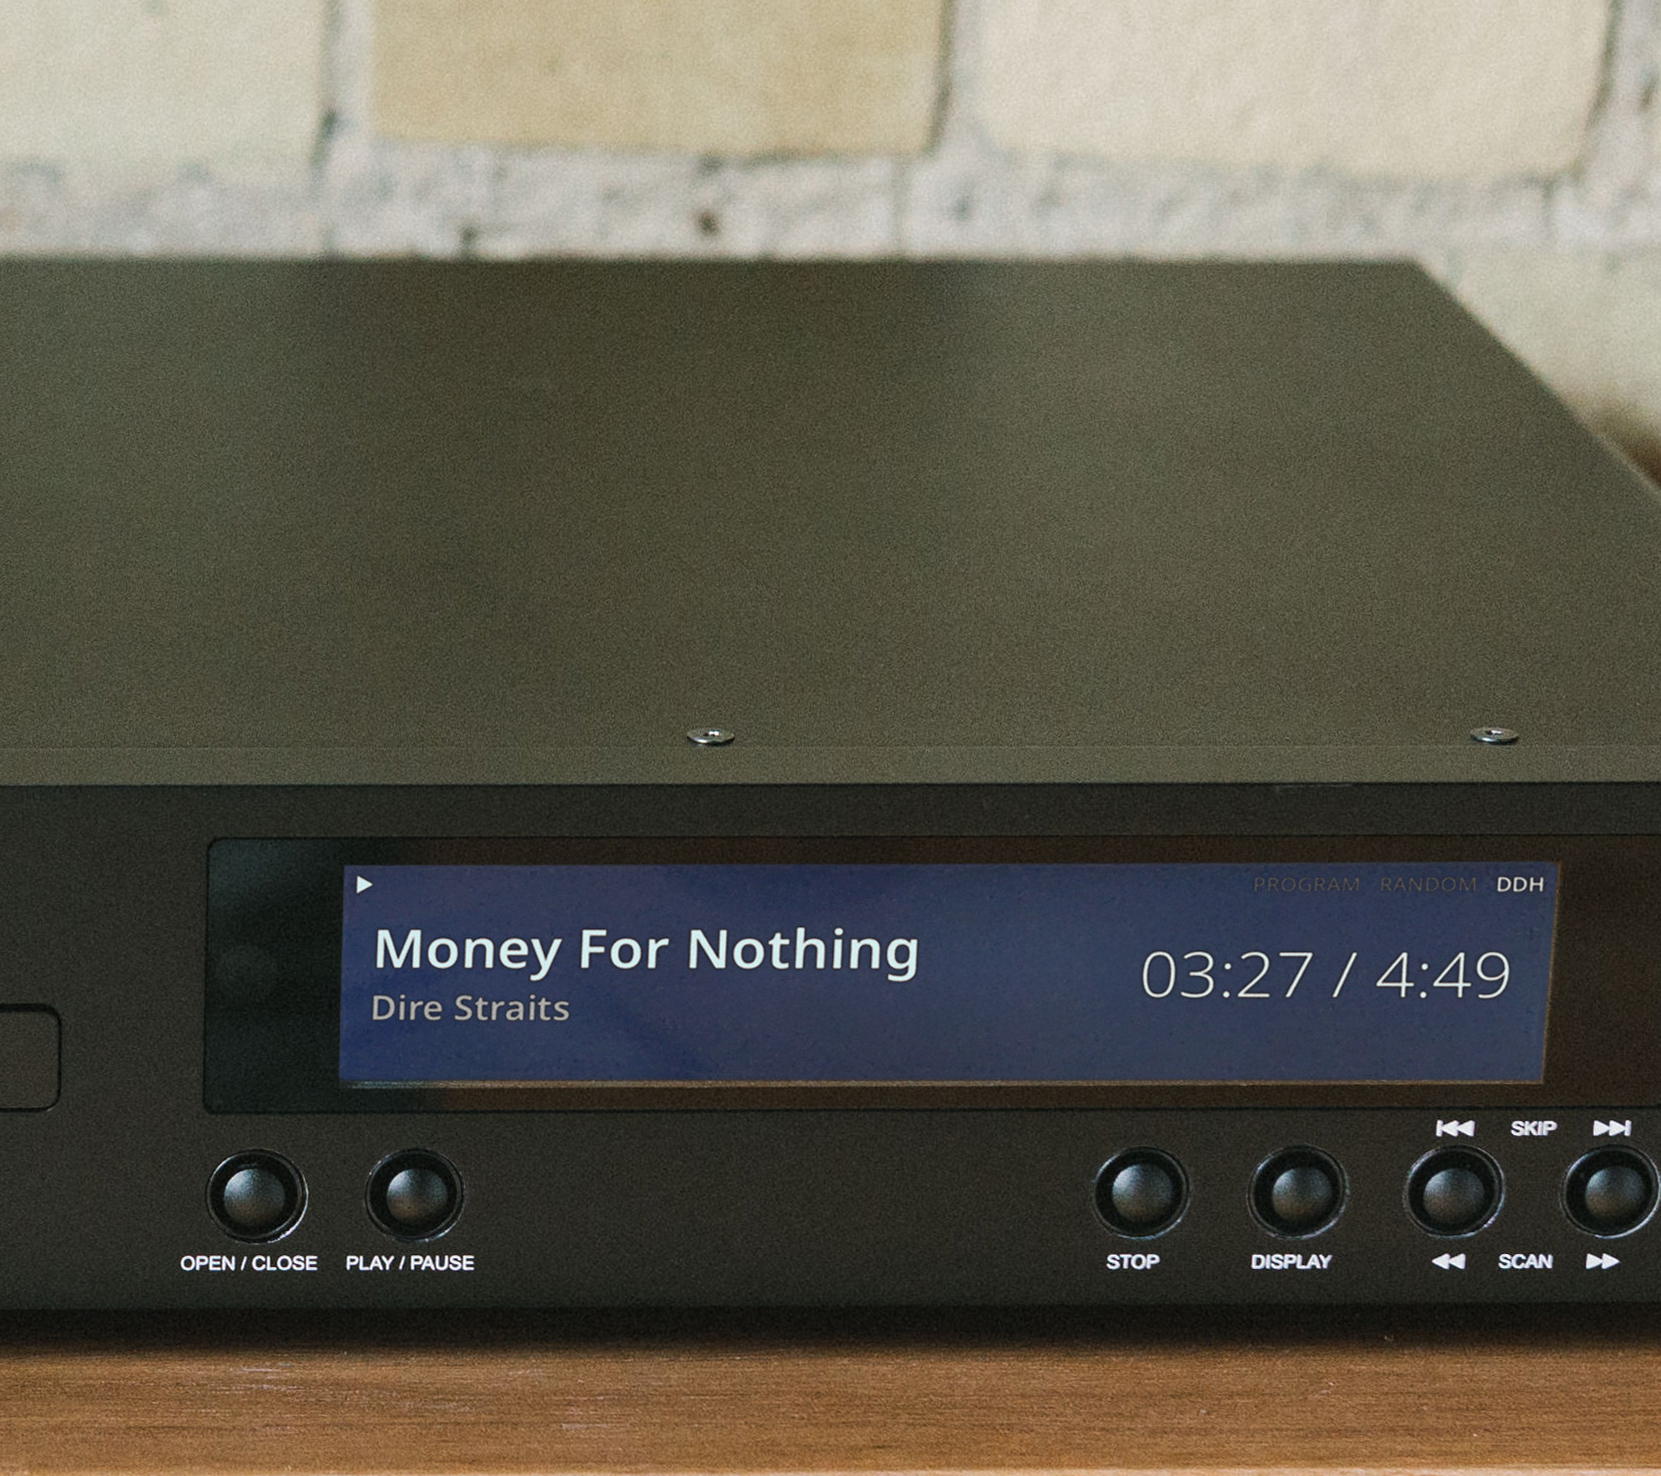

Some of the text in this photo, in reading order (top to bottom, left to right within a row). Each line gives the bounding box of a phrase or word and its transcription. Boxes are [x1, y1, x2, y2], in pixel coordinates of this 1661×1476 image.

[1253, 876, 1477, 892] PROGRAM RANDOM
[1496, 876, 1544, 893] DDH
[376, 927, 918, 982] Money For Nothing
[1142, 951, 1313, 998] 03:27
[1376, 951, 1510, 999] 4:49
[372, 995, 570, 1021] Dire Straits
[1511, 1120, 1558, 1137] SKIP
[180, 1255, 236, 1271] OPEN
[250, 1255, 317, 1271] CLOSE
[346, 1255, 395, 1271] PLAY
[410, 1255, 474, 1271] PAUSE
[1106, 1253, 1161, 1270] STOP
[1251, 1253, 1332, 1270] DISPLAY
[1498, 1253, 1553, 1270] SCAN
